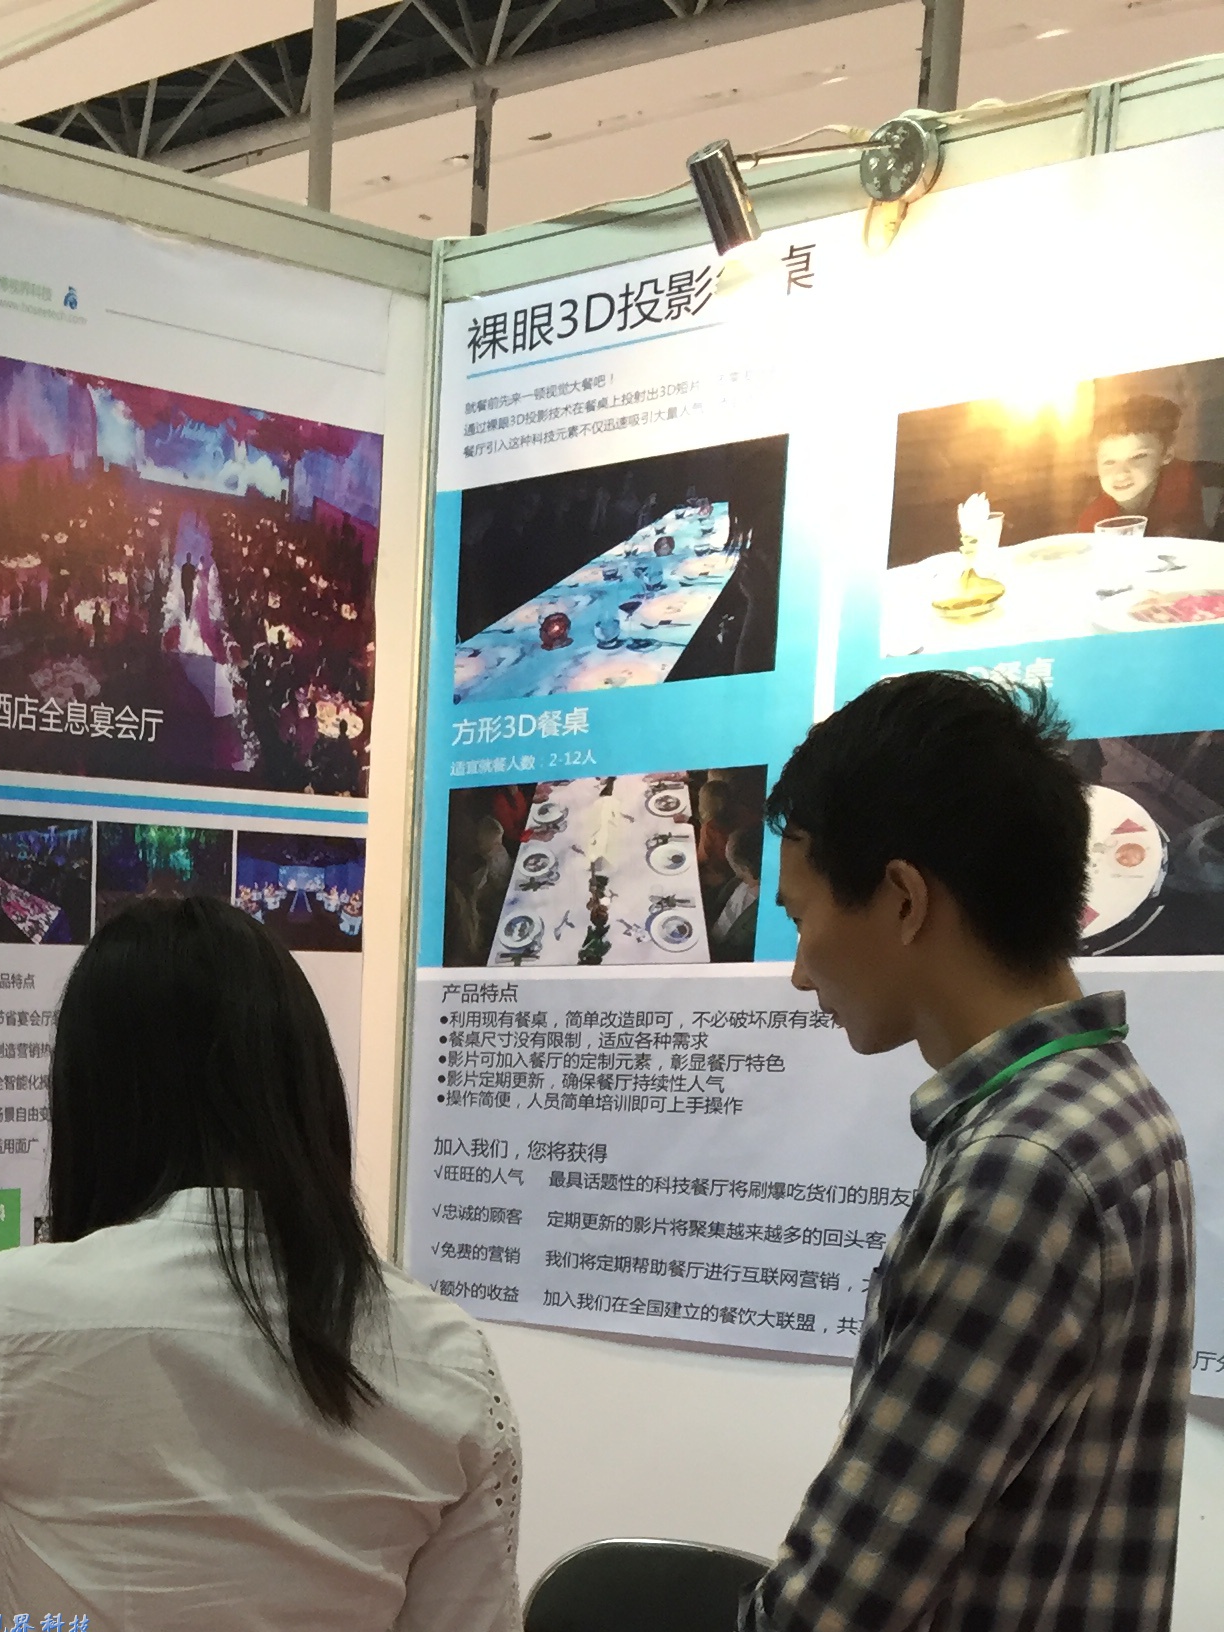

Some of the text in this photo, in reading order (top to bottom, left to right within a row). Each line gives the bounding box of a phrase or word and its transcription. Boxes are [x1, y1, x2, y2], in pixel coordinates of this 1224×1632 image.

[466, 242, 817, 364] 裸眼3D投影桌
[451, 706, 590, 747] 方形3D餐桌
[441, 982, 519, 1003] 产品特点
[448, 1030, 710, 1051] 餐桌尺寸没有限制，适应各种需求
[447, 1050, 786, 1073] 影片可加入餐厅的定制元素，彰显餐厅特色
[446, 1070, 726, 1095] 影片定期更新，确保餐厅持续性人气
[445, 1090, 744, 1115] 操作简便，人员简单培训即可上手操作
[433, 1136, 609, 1163] 加入我们，您将获得
[546, 1211, 887, 1250] 定期更新的影片将聚集越来越多的回头客
[542, 1288, 862, 1335] 加入我们在全国建立的餐饮大联盟，共
